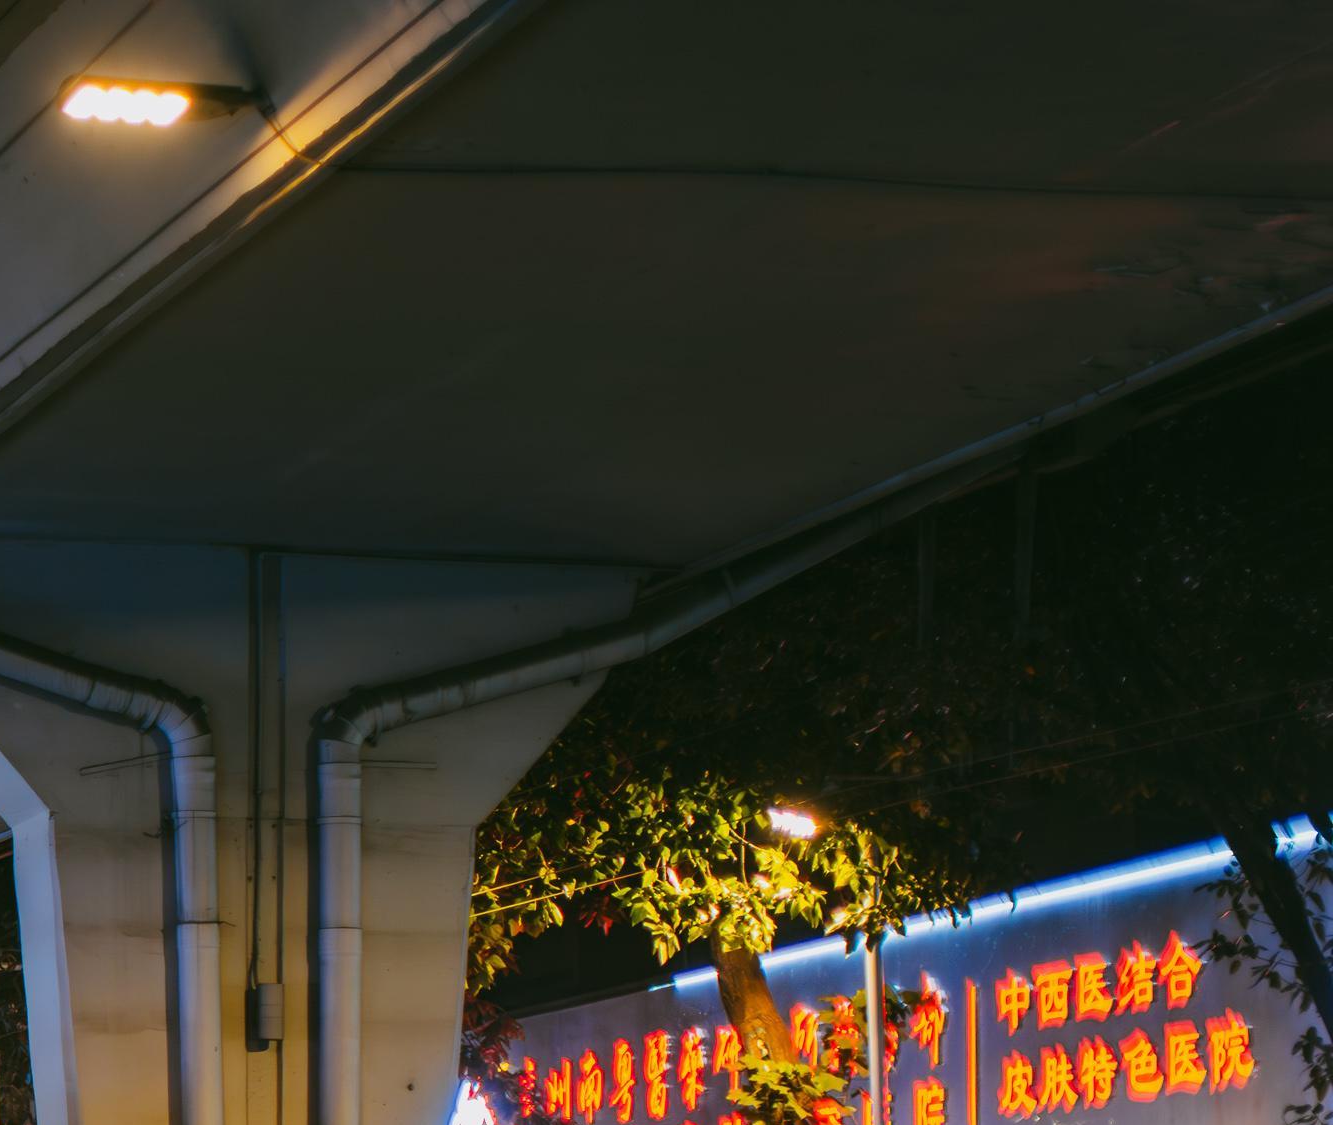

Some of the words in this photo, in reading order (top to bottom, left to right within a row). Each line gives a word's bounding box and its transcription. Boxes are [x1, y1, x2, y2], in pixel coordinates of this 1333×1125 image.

[995, 929, 1203, 1037] 中西医结合
[997, 1006, 1255, 1120] 皮肤特色医院
